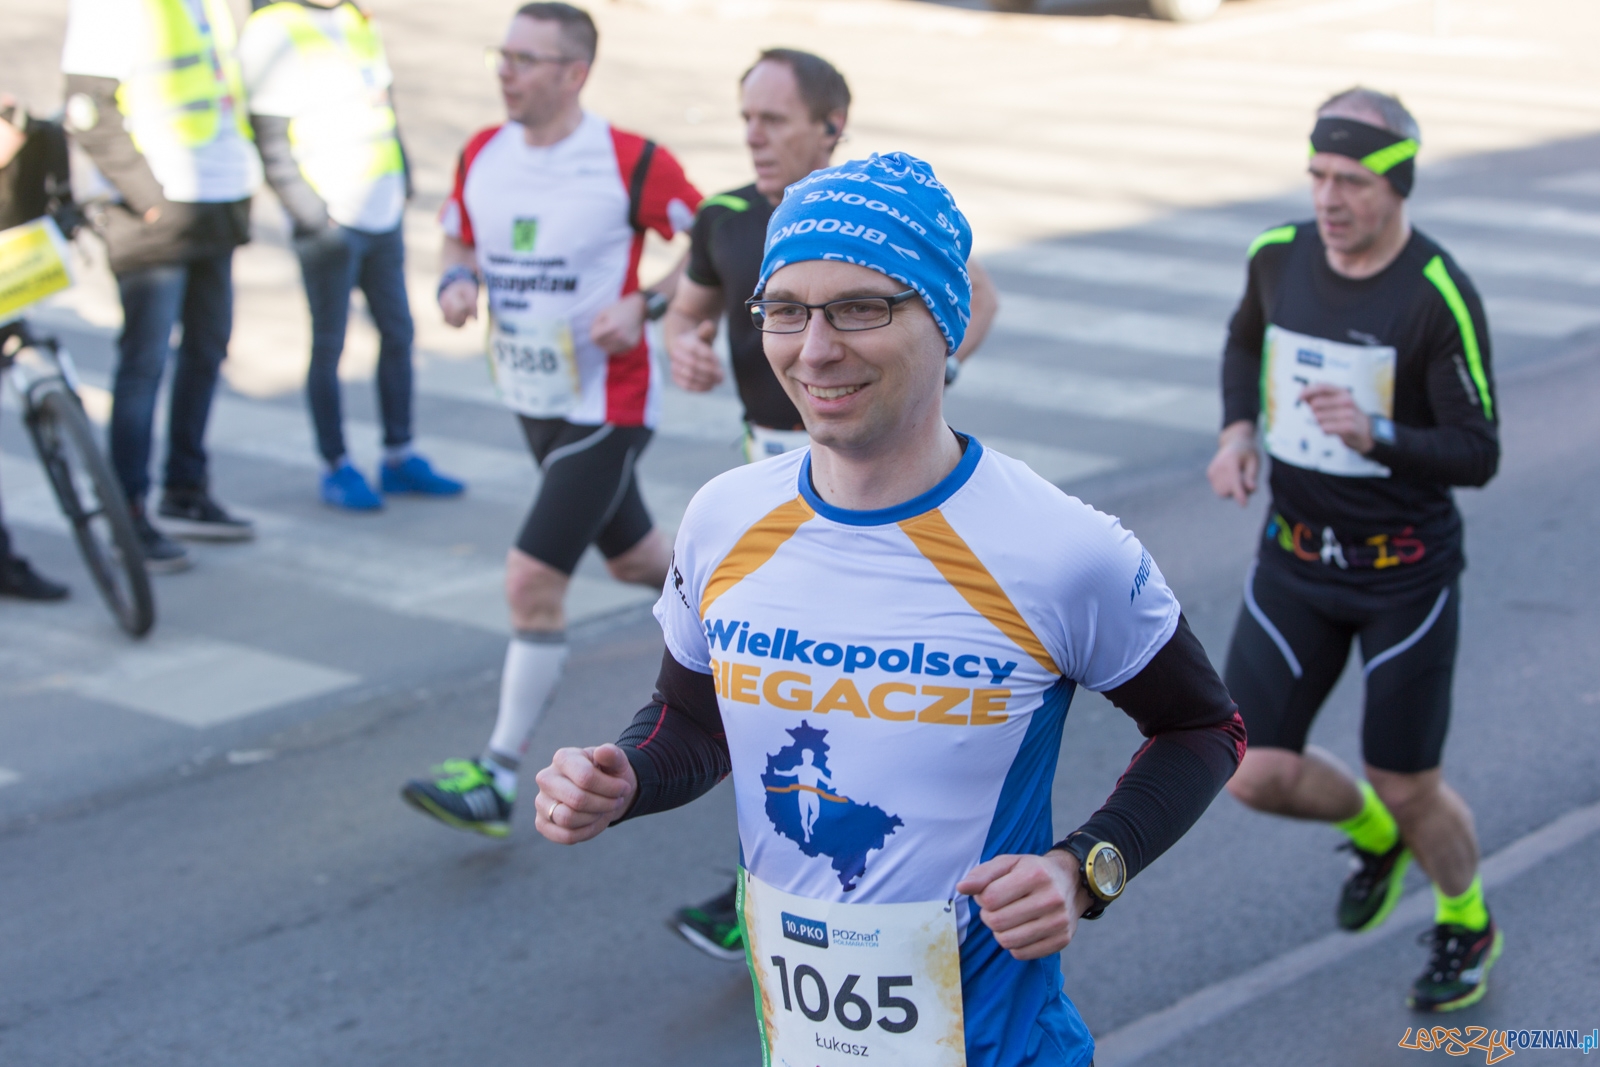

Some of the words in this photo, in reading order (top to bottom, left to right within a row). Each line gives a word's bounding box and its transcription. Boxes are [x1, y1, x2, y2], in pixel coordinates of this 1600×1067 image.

[769, 218, 888, 246] BROOKS
[704, 618, 1018, 684] Wielkopolscy
[784, 919, 825, 941] 10.PKO
[770, 954, 919, 1034] 1065
[815, 1032, 870, 1058] Łukasz
